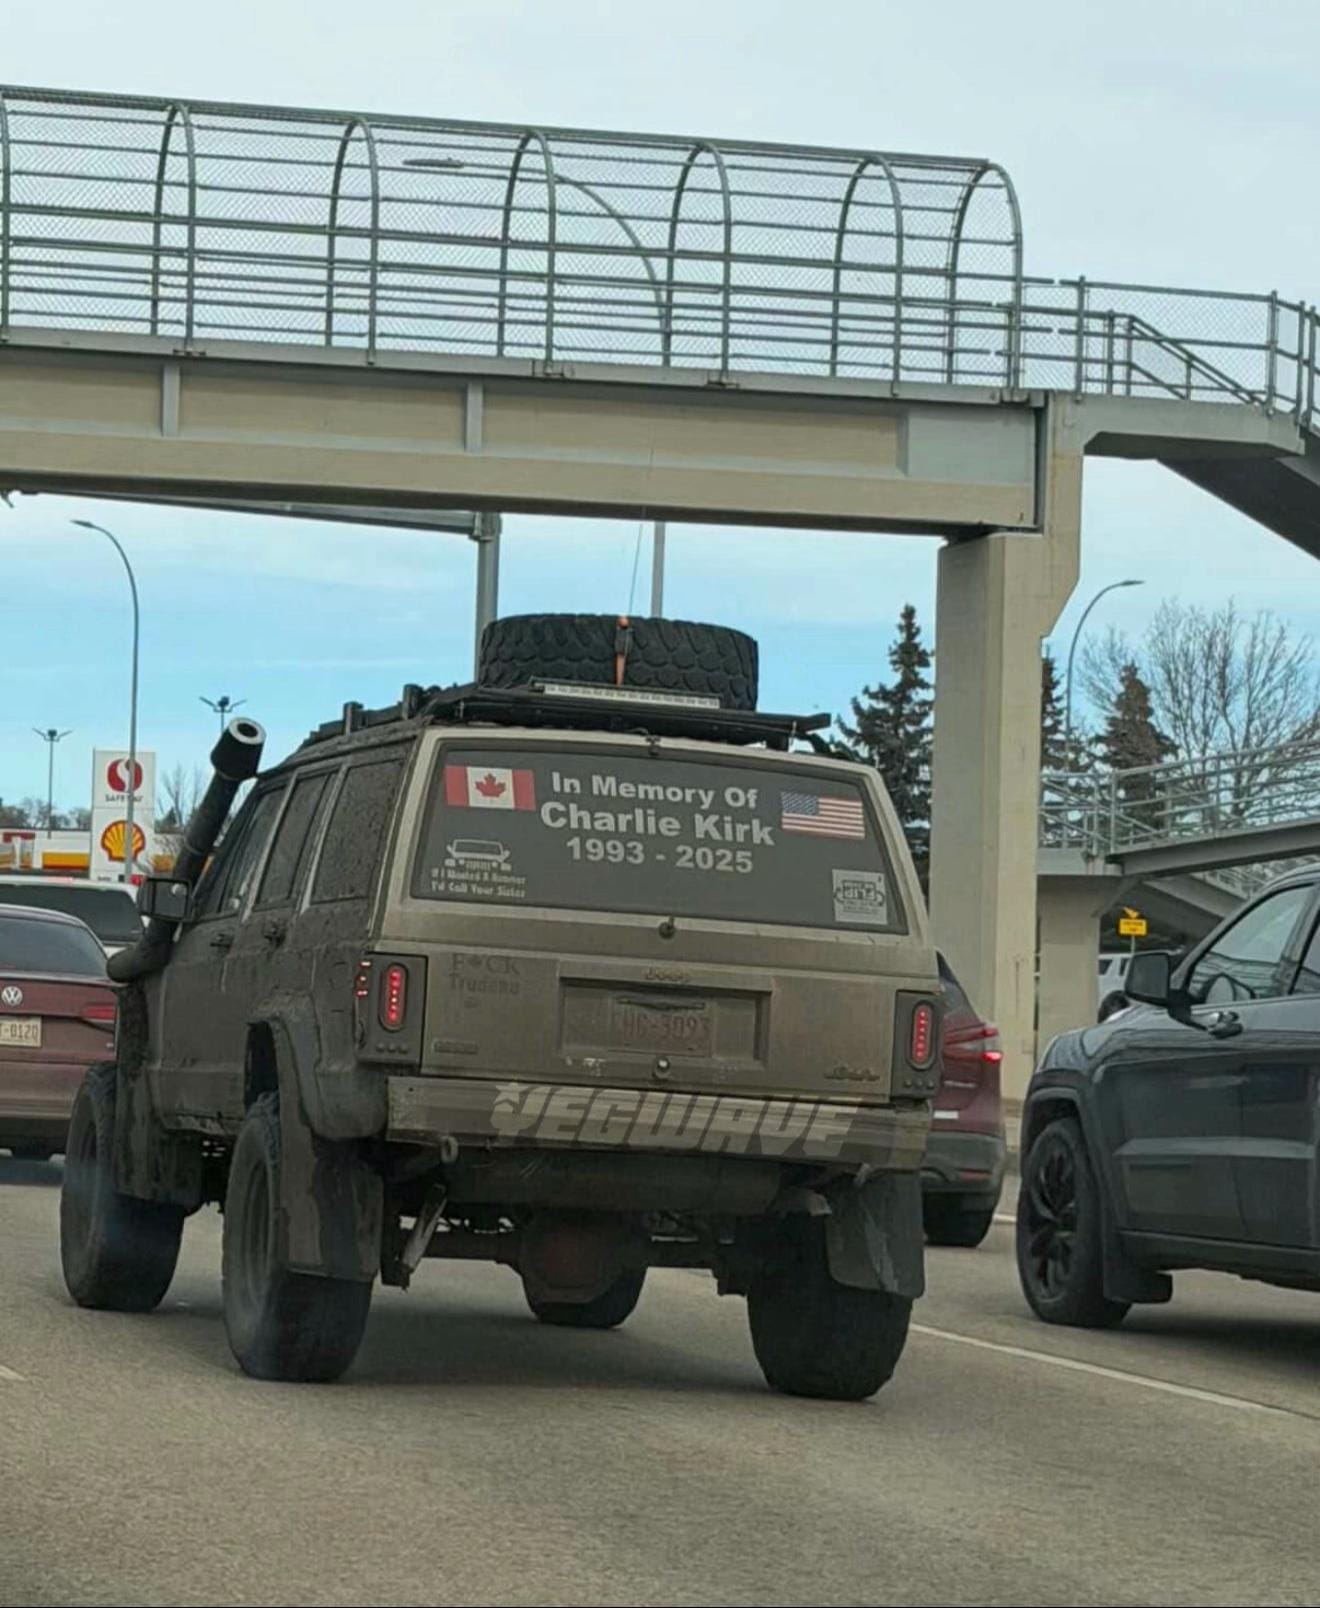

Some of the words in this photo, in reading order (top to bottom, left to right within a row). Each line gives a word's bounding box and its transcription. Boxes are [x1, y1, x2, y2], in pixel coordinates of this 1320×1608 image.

[105, 794, 143, 802] SAFEAY
[551, 771, 581, 794] In
[591, 774, 715, 809] Memory
[724, 786, 758, 809] Of
[540, 801, 681, 837] Charlie
[694, 813, 775, 846] Kirk
[566, 837, 645, 864] 1993
[675, 844, 754, 873] 2025
